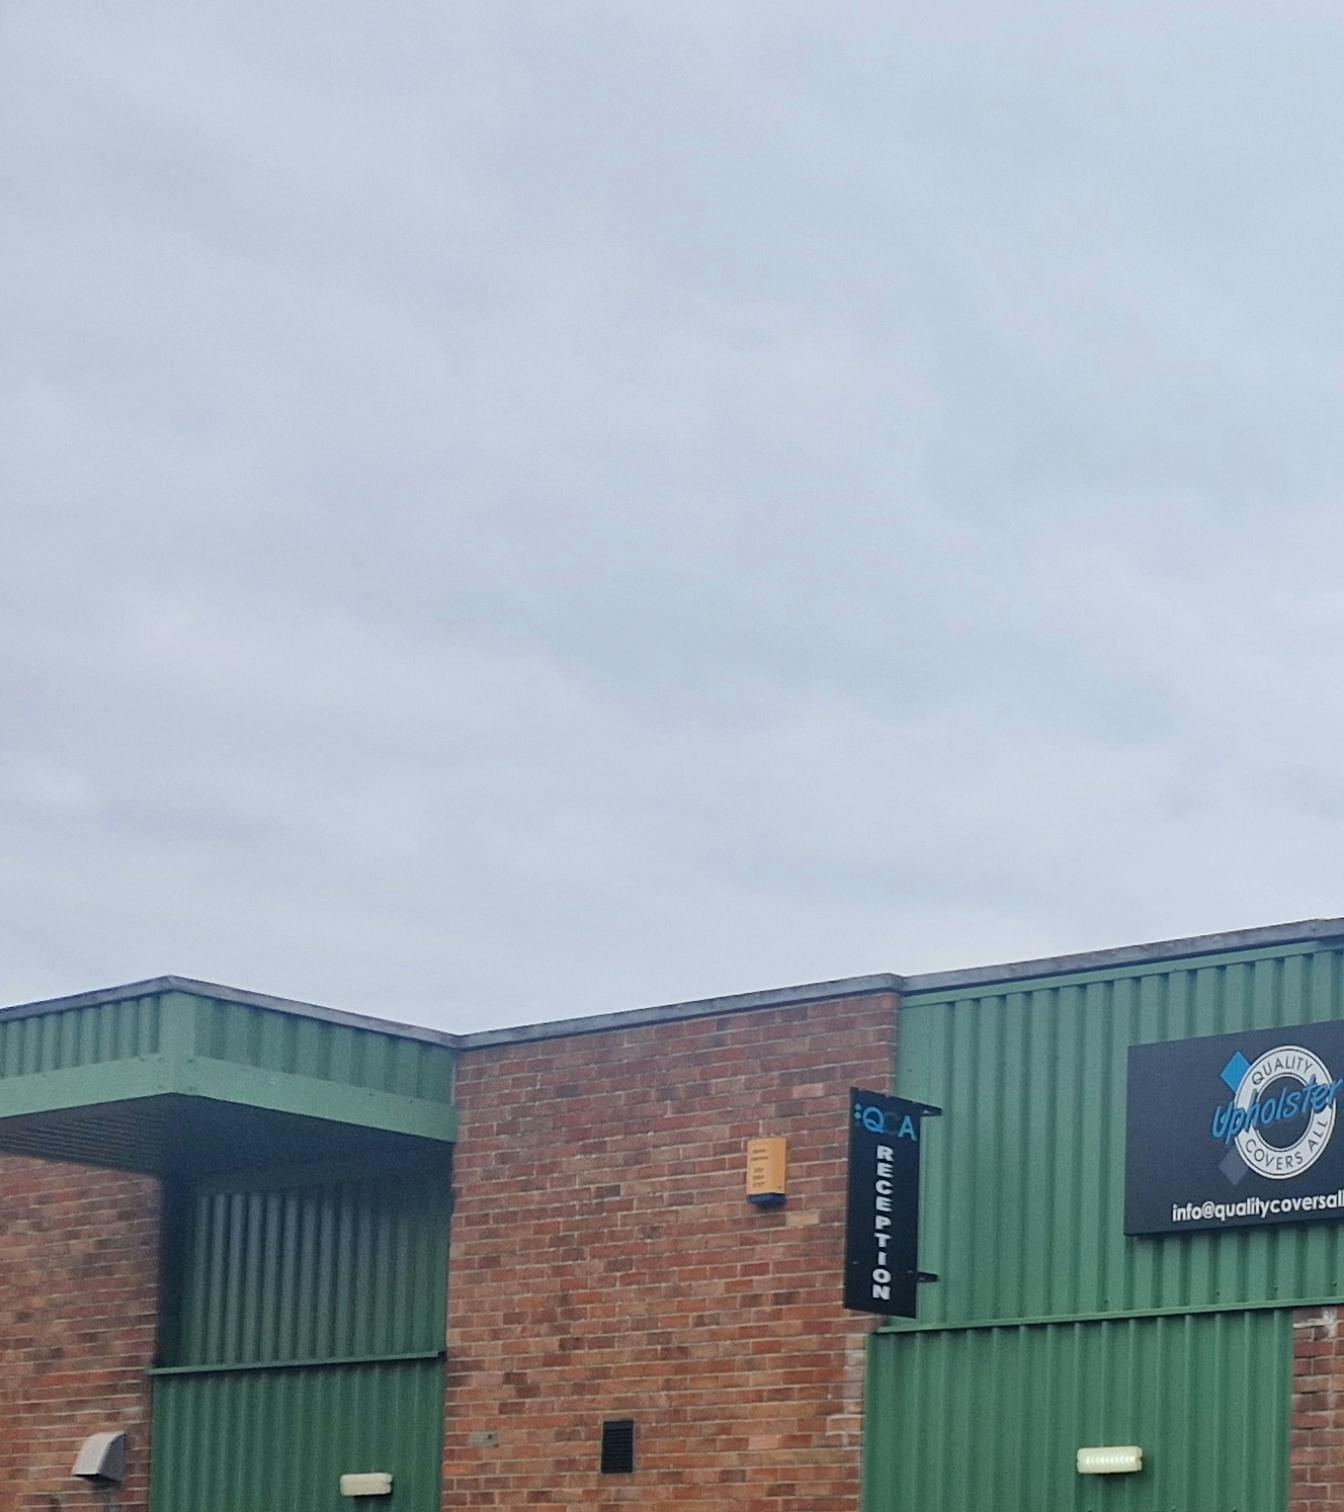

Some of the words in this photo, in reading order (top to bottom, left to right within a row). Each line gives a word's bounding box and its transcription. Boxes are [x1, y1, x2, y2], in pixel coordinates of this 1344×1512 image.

[1252, 1056, 1313, 1086] QUALITY
[1245, 1139, 1303, 1171] COVERS
[1308, 1120, 1327, 1152] ALL
[872, 1145, 895, 1300] RECEPTION
